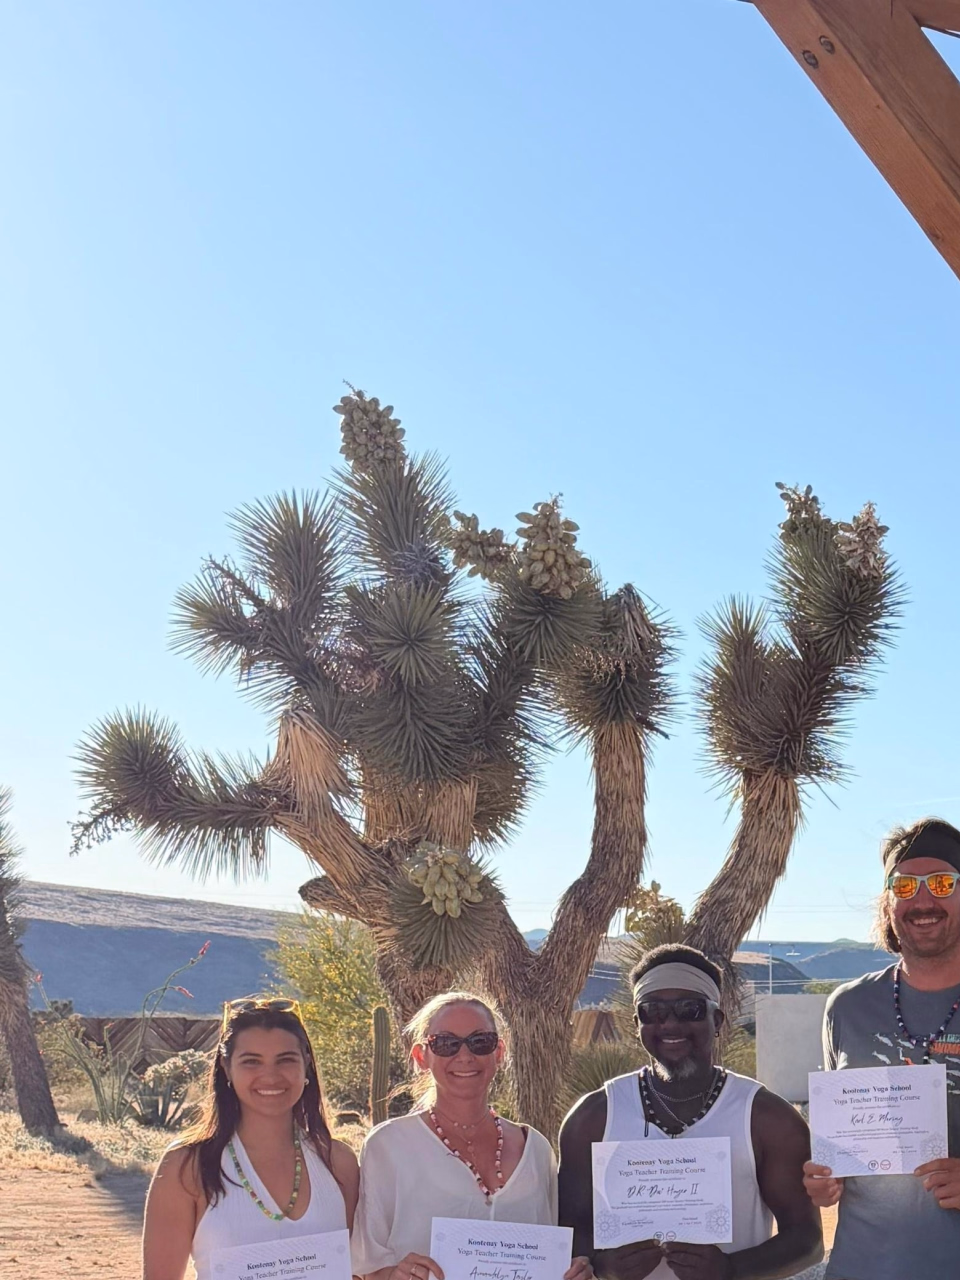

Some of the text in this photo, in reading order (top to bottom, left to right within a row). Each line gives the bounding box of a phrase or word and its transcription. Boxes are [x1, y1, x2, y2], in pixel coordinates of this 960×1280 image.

[468, 1238, 497, 1247] Kootenay
[517, 1242, 538, 1250] School
[247, 1261, 276, 1270] Kootenay
[295, 1254, 316, 1262] School
[500, 1252, 524, 1260] Training
[526, 1253, 546, 1261] Course
[256, 1271, 278, 1279] Teacher
[280, 1266, 304, 1275] Training
[306, 1263, 326, 1271] Course
